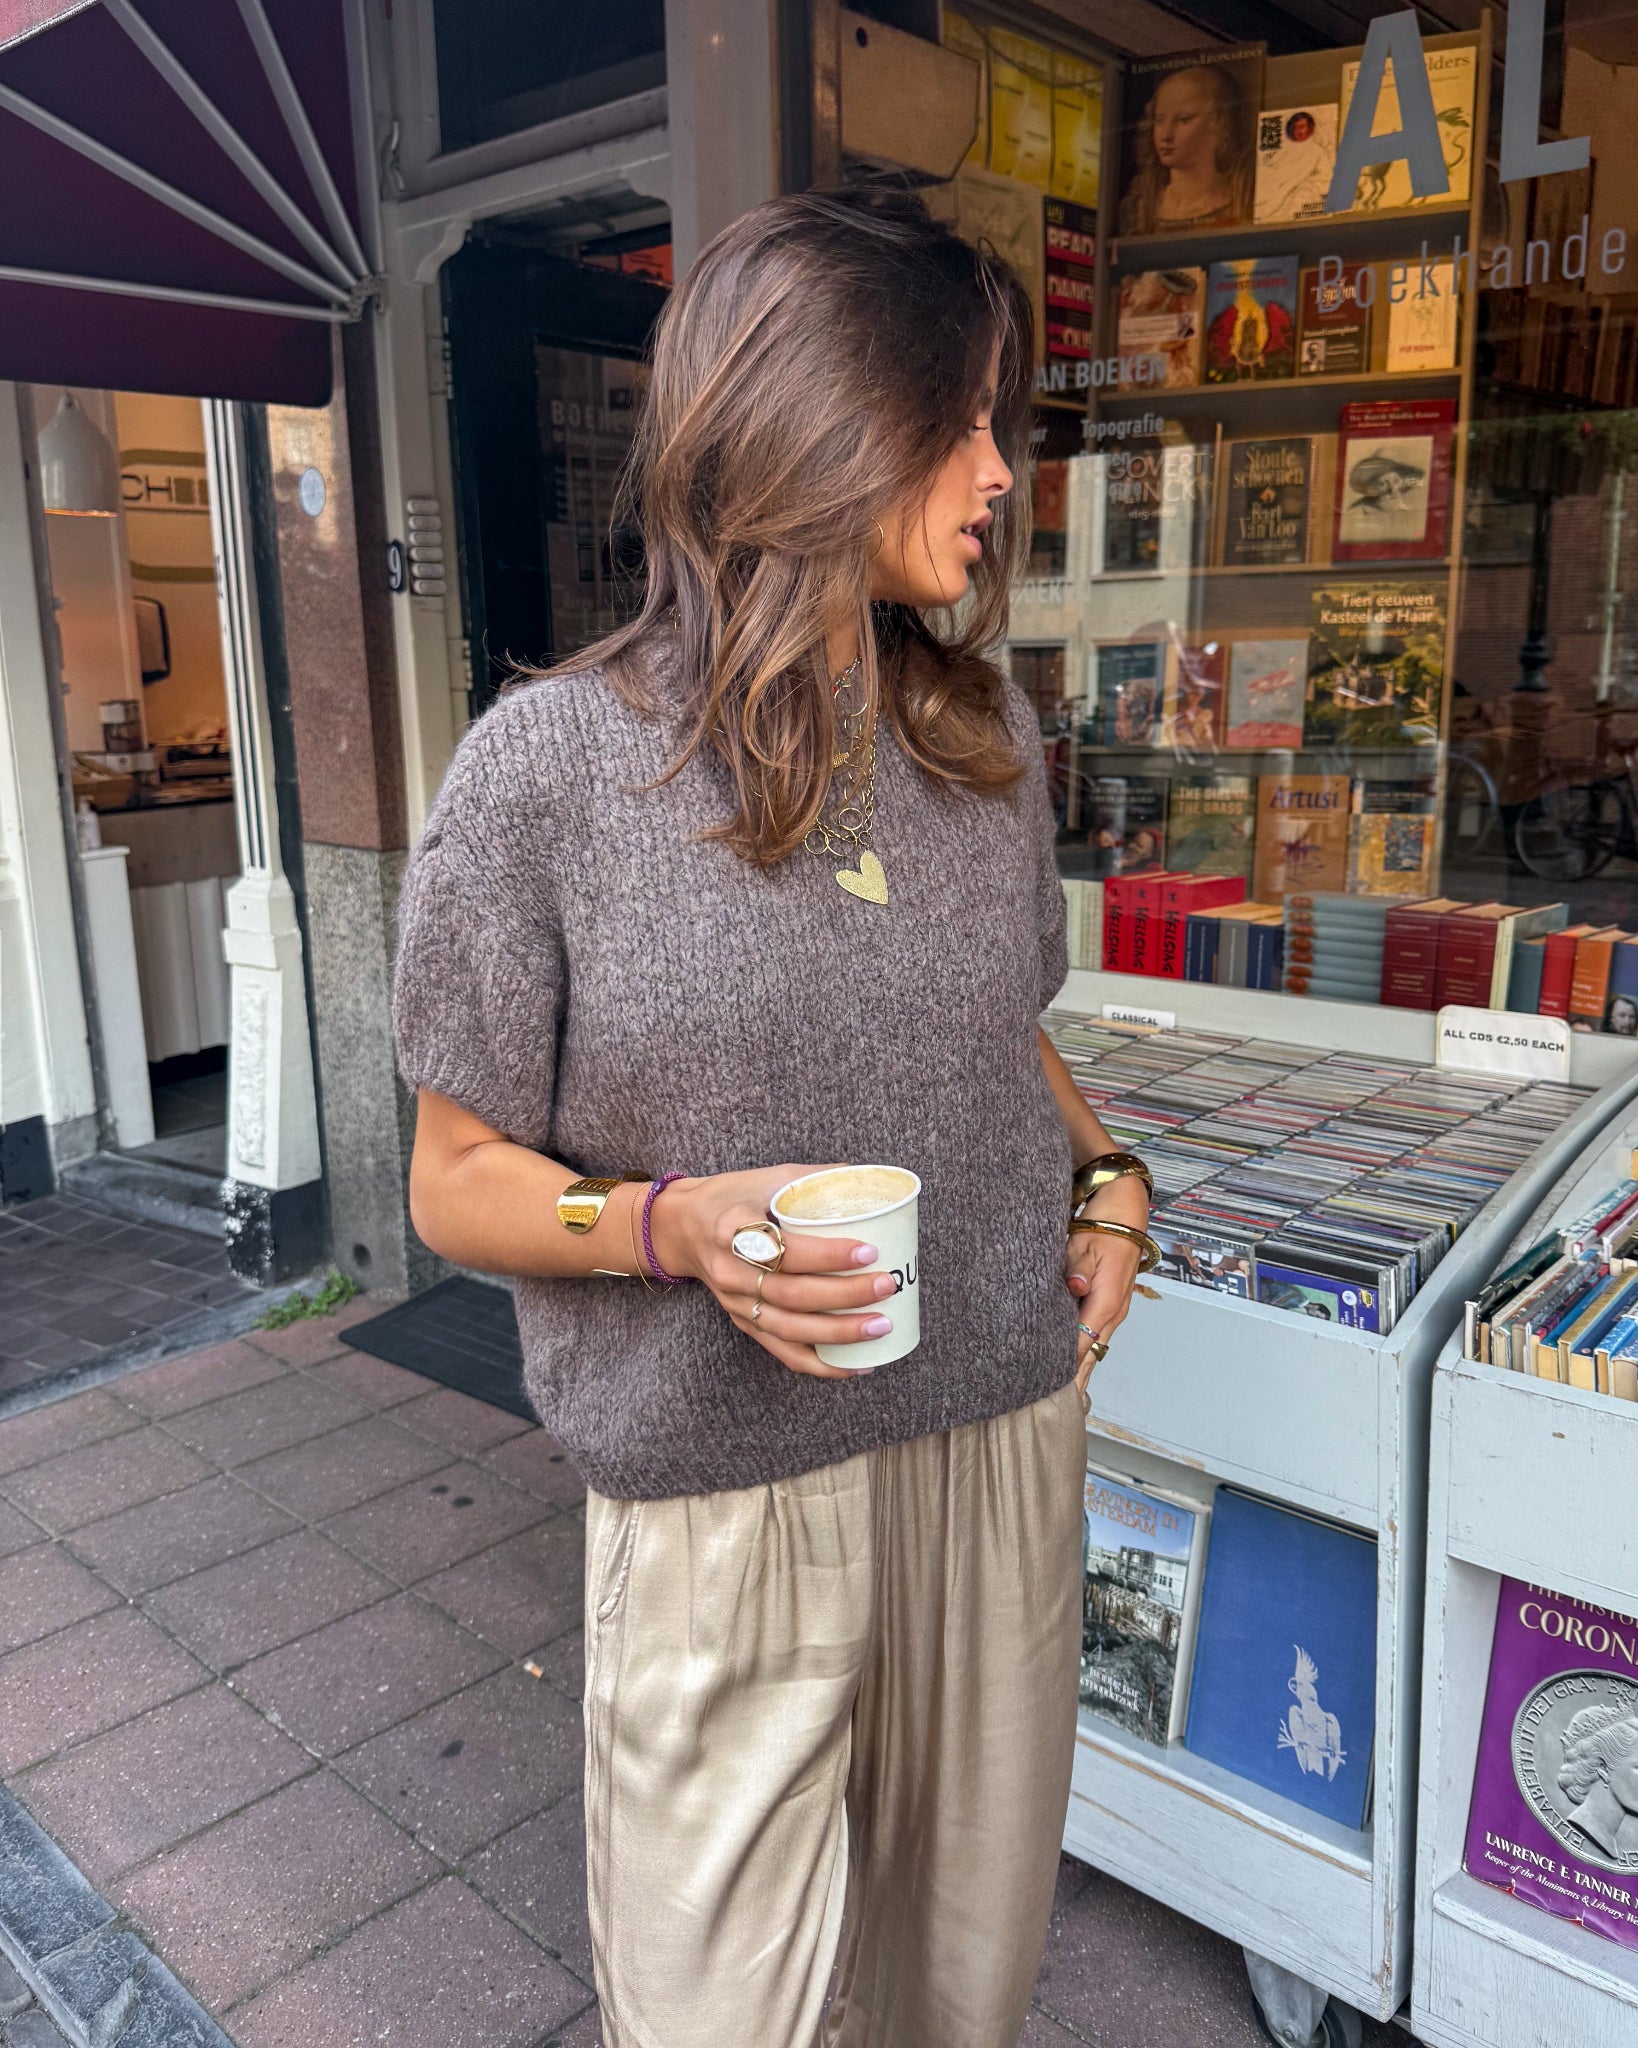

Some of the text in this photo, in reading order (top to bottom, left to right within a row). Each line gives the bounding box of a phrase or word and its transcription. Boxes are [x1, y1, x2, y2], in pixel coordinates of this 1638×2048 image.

[1317, 213, 1626, 314] Boekhande
[1033, 352, 1167, 393] AN BOEKEN
[1080, 412, 1165, 441] Topografie
[387, 544, 402, 590] 9
[1320, 609, 1433, 625] Kasteel de Haar
[1341, 593, 1434, 607] Tien eeuwen
[1178, 801, 1200, 814] THE
[1268, 782, 1340, 809] Artusi
[1107, 904, 1122, 967] HELLSING
[1132, 907, 1149, 970] HELLSING
[1162, 910, 1180, 975] HELLSING
[1111, 1011, 1159, 1027] CLASSICAL
[1443, 1029, 1466, 1040] ALL
[1469, 1032, 1493, 1043] CDS
[1532, 1039, 1564, 1053] EACH
[1162, 1511, 1180, 1532] IN
[1519, 1602, 1638, 1667] CORON
[1485, 1850, 1508, 1870] Keeper
[1510, 1864, 1521, 1875] of
[1521, 1867, 1534, 1879] the
[1536, 1873, 1580, 1900] Muniments
[1581, 1895, 1590, 1908] &
[1486, 1831, 1631, 1906] LAWRENCE E. TANNER
